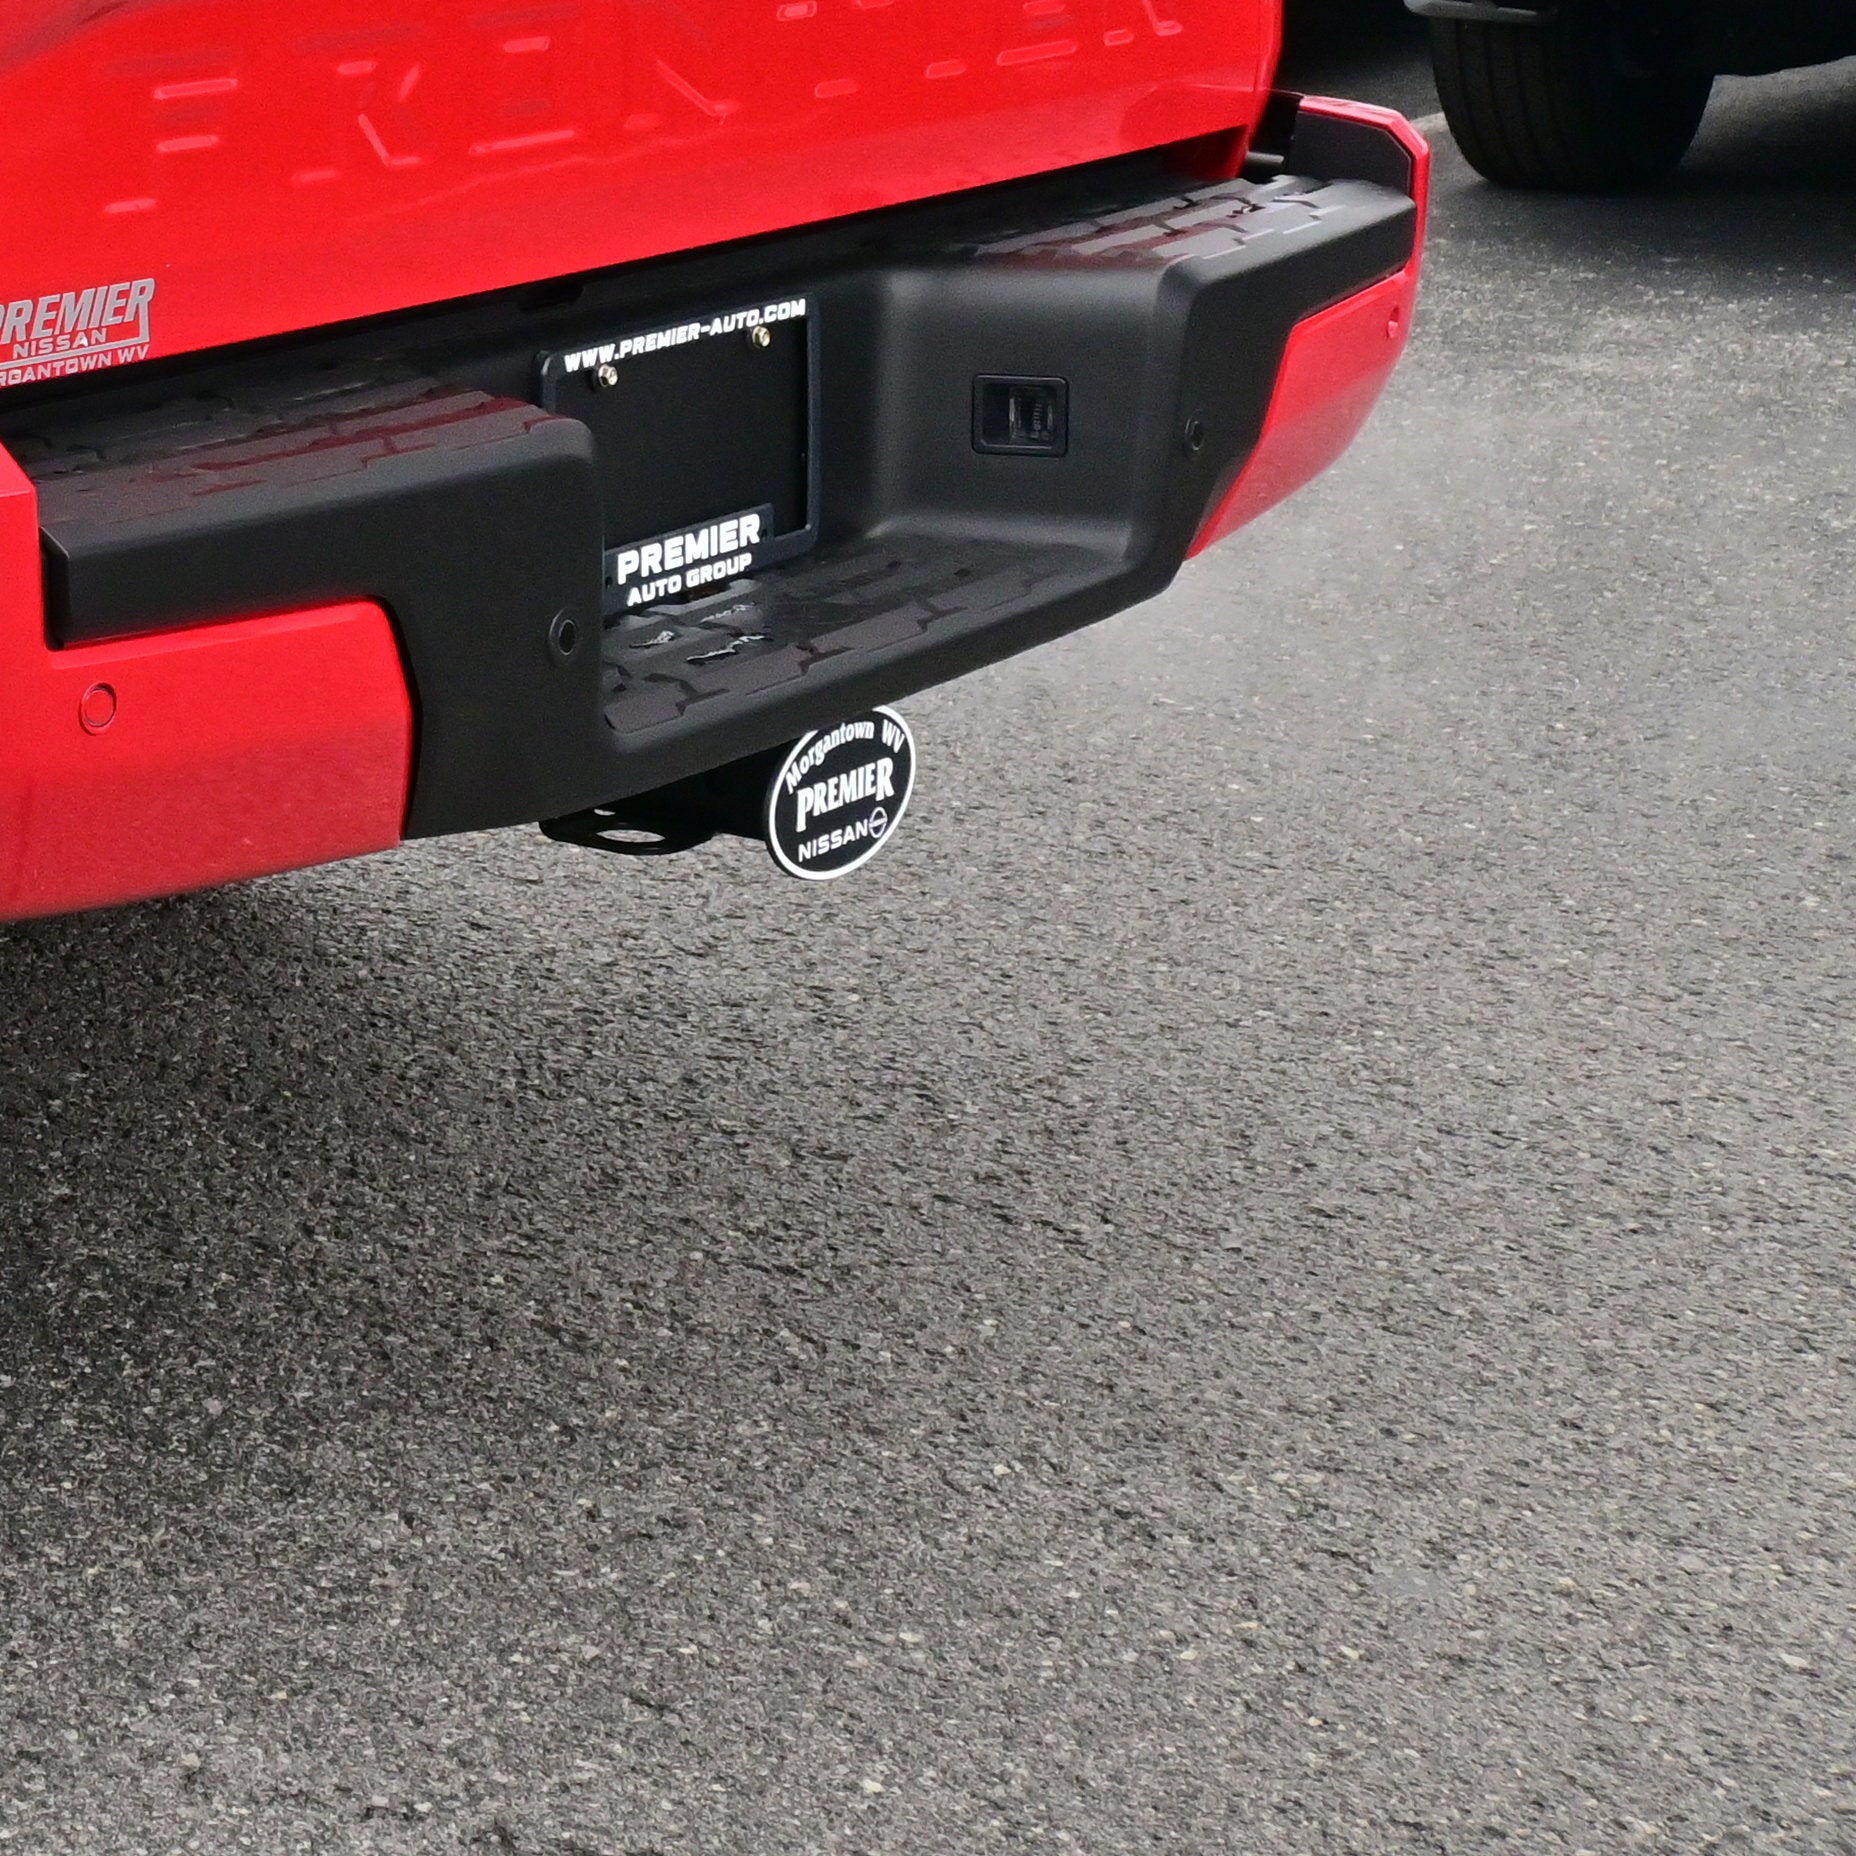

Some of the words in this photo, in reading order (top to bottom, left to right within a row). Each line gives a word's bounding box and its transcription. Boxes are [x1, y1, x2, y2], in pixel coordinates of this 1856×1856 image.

[12, 328, 108, 360] NISSAN
[117, 344, 150, 364] WV
[564, 298, 806, 372] WWW.PREMIER-AUTO.COM
[616, 513, 761, 586] PREMIER
[626, 574, 682, 607] AUTO
[686, 552, 753, 588] GROUP
[785, 720, 875, 795] Morgantown
[882, 718, 906, 754] WV
[795, 756, 895, 832] PREMIER
[798, 818, 869, 863] NISSAN
